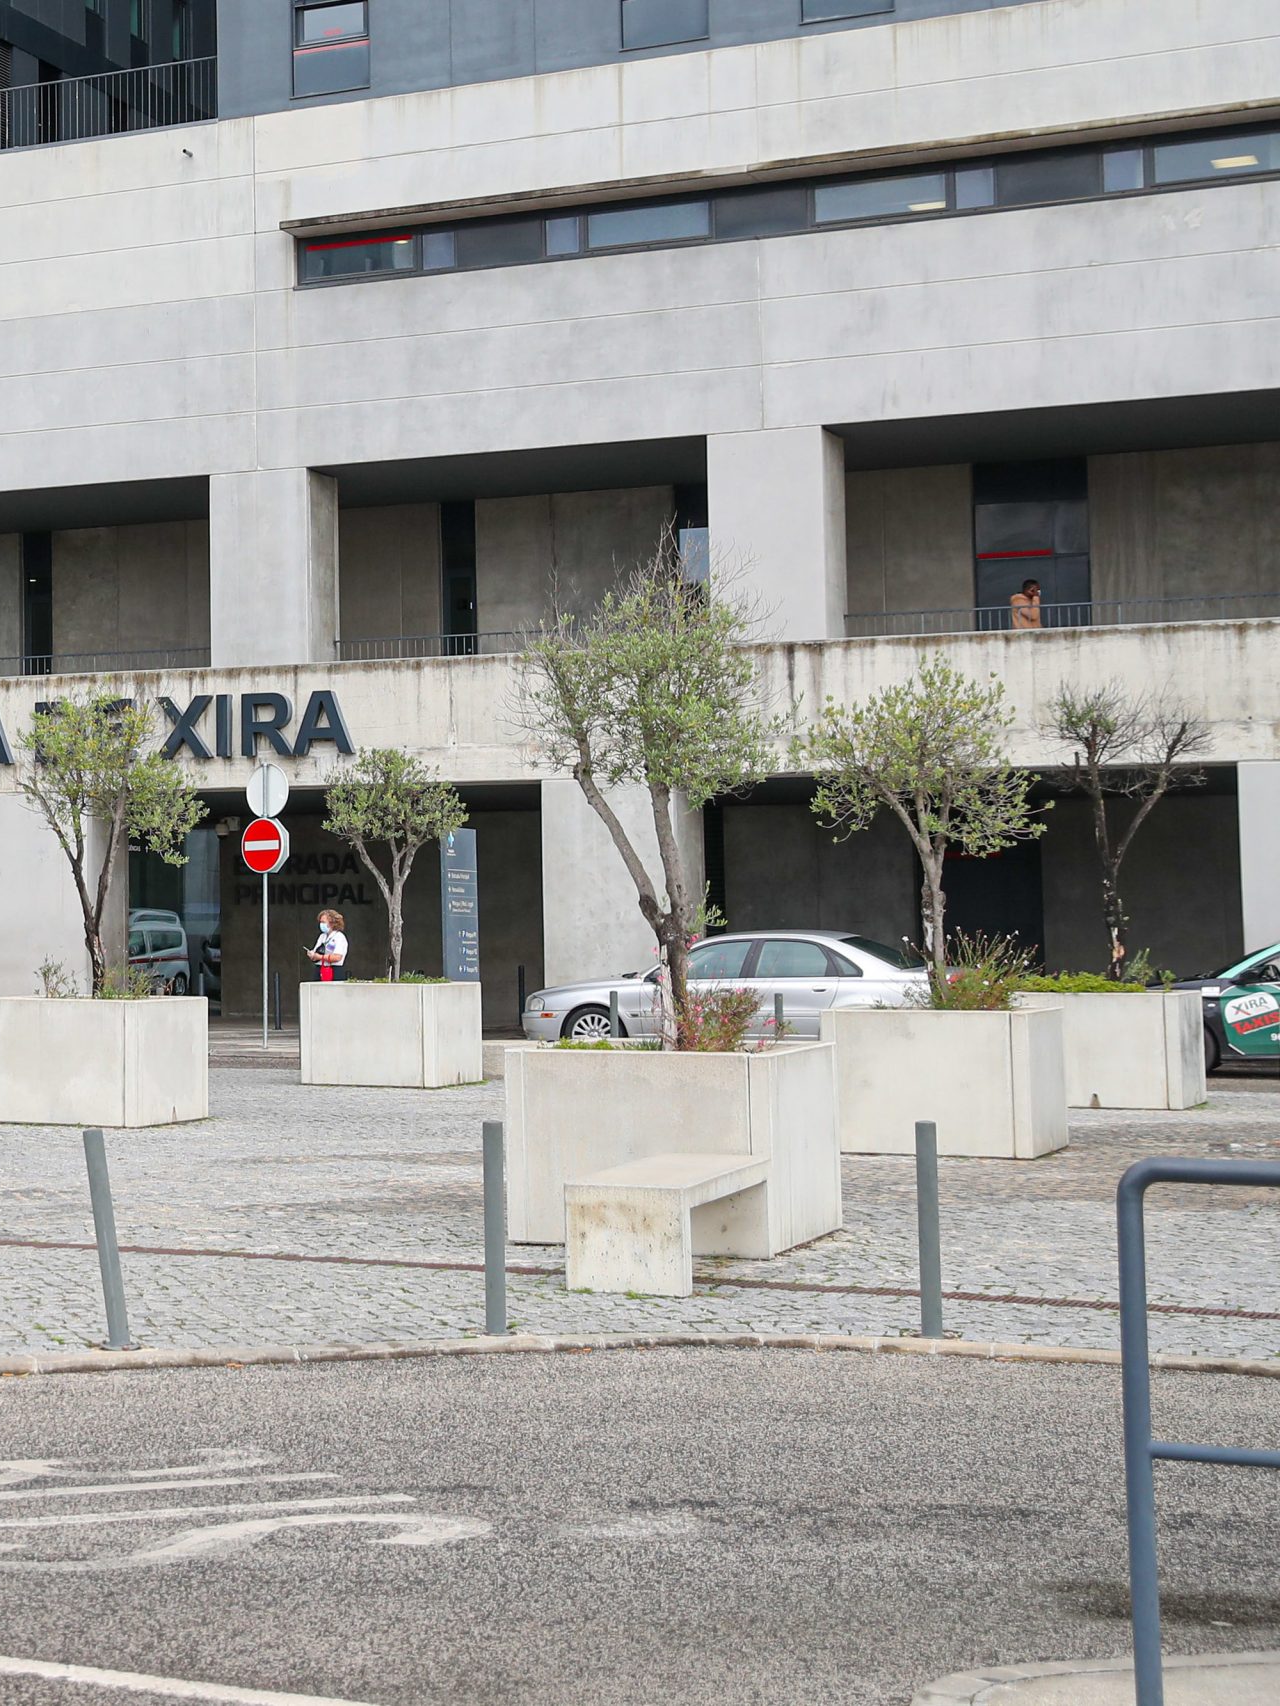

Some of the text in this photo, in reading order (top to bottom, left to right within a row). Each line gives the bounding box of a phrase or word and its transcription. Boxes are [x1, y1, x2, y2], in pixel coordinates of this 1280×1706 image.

[156, 690, 356, 760] XIRA
[1232, 996, 1268, 1016] XIRA
[1232, 1011, 1280, 1035] TAXIS
